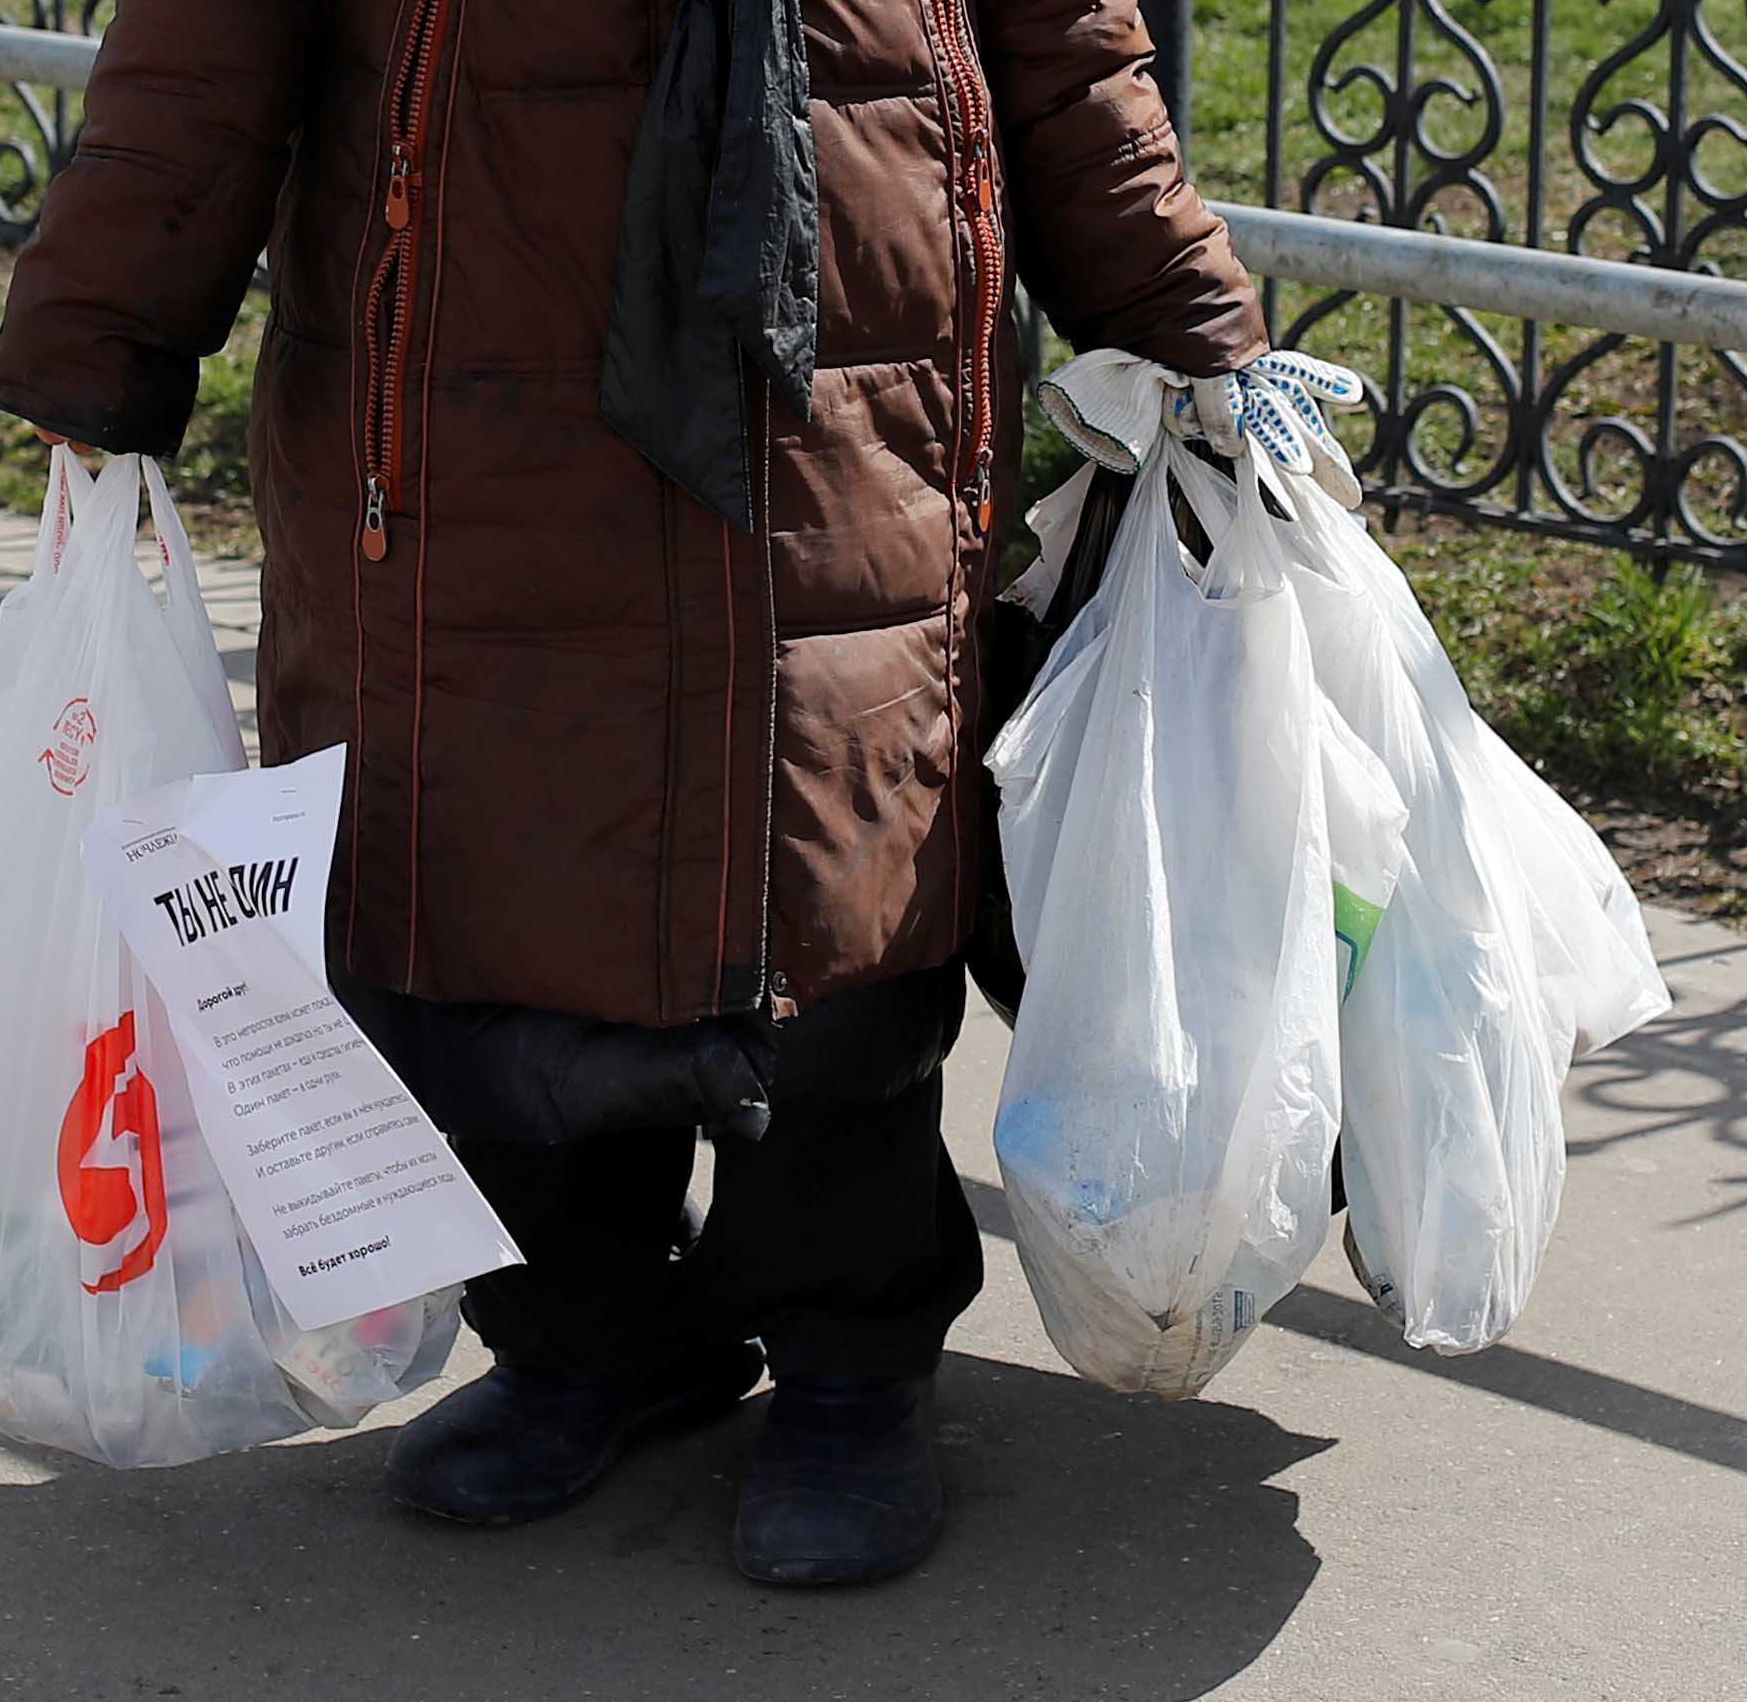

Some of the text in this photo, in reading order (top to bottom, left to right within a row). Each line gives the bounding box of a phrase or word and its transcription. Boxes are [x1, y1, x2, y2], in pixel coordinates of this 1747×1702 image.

[153, 883, 206, 947] ТЫ
[193, 870, 239, 933] НЕ
[197, 986, 233, 1011] Дорогой
[213, 1036, 222, 1048] В
[222, 1032, 238, 1045] это
[221, 1058, 240, 1070] что
[227, 1081, 236, 1095] В
[239, 1073, 260, 1091] этих
[234, 1098, 266, 1116] Один
[266, 1088, 292, 1105] пакет
[246, 1130, 298, 1157] Заберите
[255, 1166, 266, 1179] И
[266, 1152, 313, 1176] оставьте
[272, 1202, 288, 1217] Не
[288, 1181, 353, 1212] выкидывайте
[282, 1219, 319, 1240] забрать
[318, 1201, 377, 1227] бездомные
[298, 1235, 391, 1277] Всё будет хорошо!
